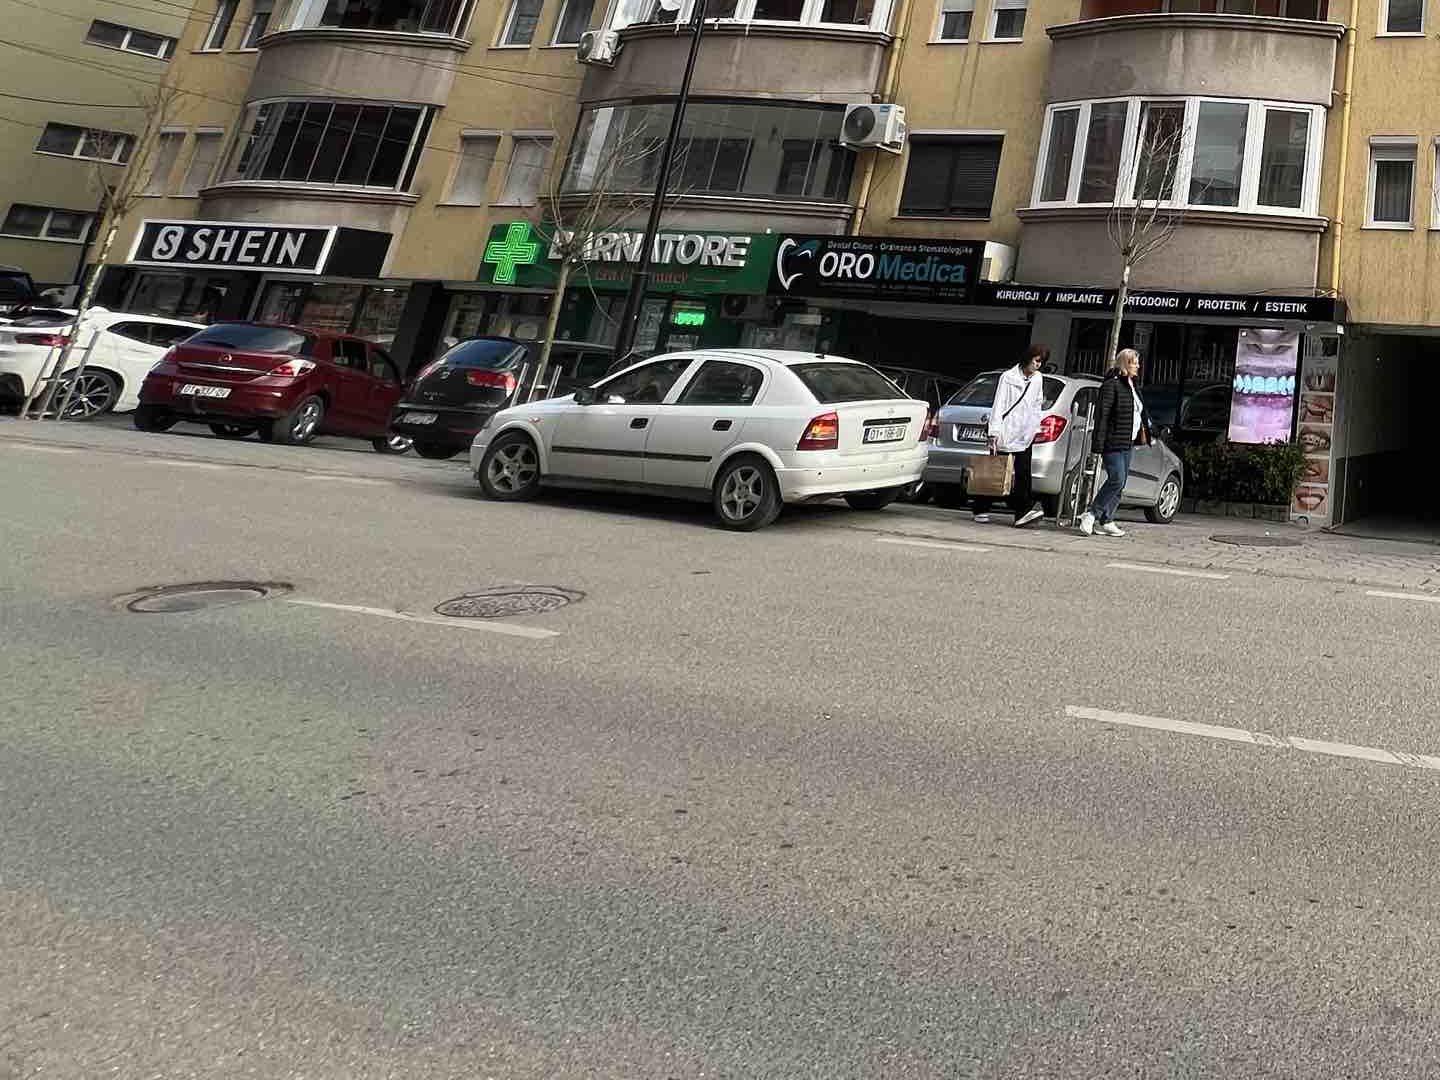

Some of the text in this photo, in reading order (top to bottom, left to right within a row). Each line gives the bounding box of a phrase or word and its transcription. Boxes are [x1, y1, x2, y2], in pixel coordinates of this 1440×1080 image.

[186, 228, 306, 265] SHEIN
[819, 251, 967, 283] ORO Medica
[996, 290, 1039, 302] KIRURGJI
[1056, 293, 1104, 304] IMPLANTE
[1122, 296, 1179, 308] ORTODONCI
[1198, 299, 1247, 311] PROTETIK
[1265, 302, 1308, 313] ESTETIK
